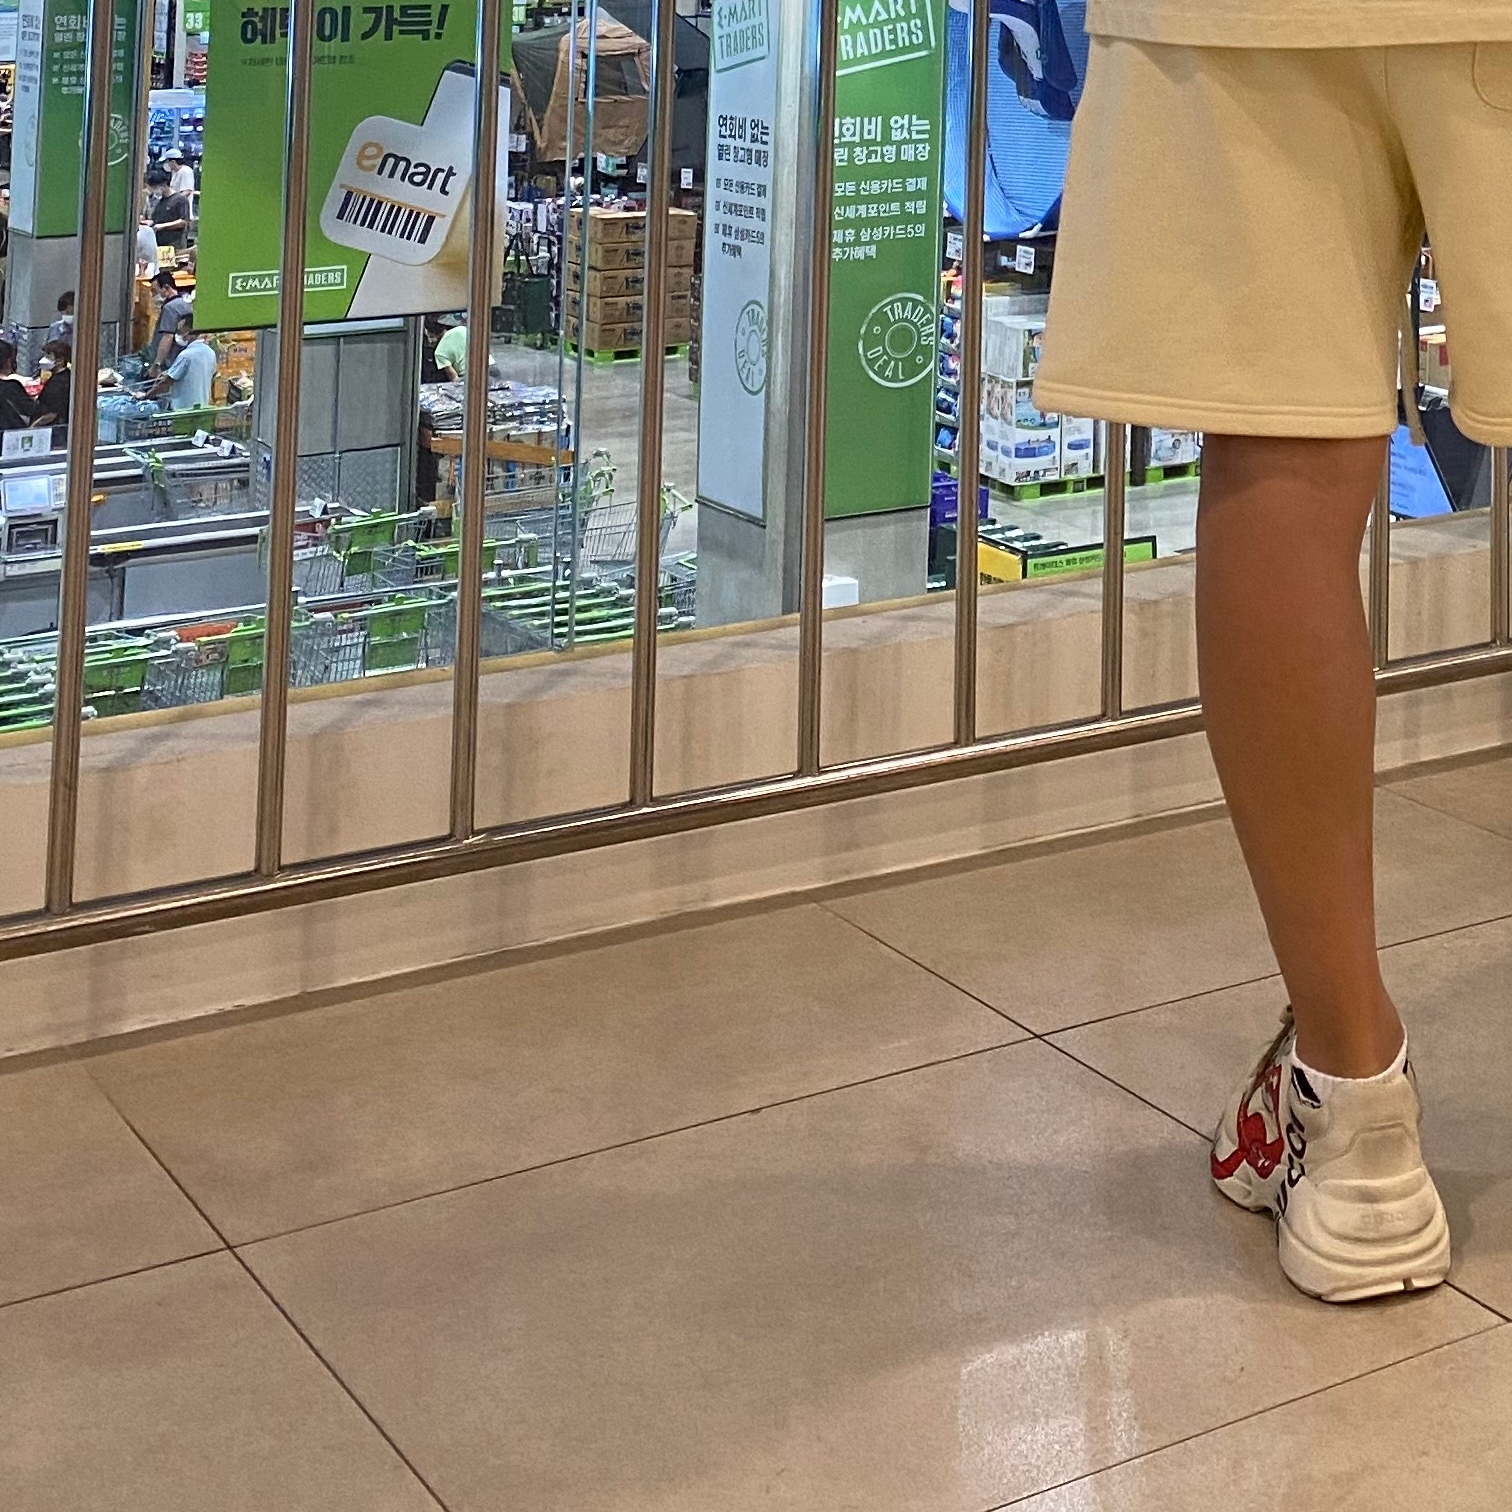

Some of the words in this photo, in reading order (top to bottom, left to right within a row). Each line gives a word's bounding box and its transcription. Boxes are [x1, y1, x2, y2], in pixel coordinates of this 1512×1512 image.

[240, 4, 352, 45] 혜이
[361, 3, 450, 42] 가득!
[840, 18, 924, 61] RADERS
[718, 114, 747, 143] 연회비
[750, 118, 770, 145] 없는
[890, 114, 931, 141] 없는
[355, 141, 457, 196] emart
[834, 147, 848, 167] 린
[853, 144, 896, 166] 창고형
[900, 143, 931, 162] 매장
[834, 183, 856, 196] 모든
[858, 179, 903, 195] 신용카드
[833, 202, 901, 220] 신세계포인트
[905, 200, 927, 216] 적립
[859, 223, 926, 241] 삼성카드5의
[831, 245, 877, 261] 추가혜택
[867, 346, 906, 380] DEAL
